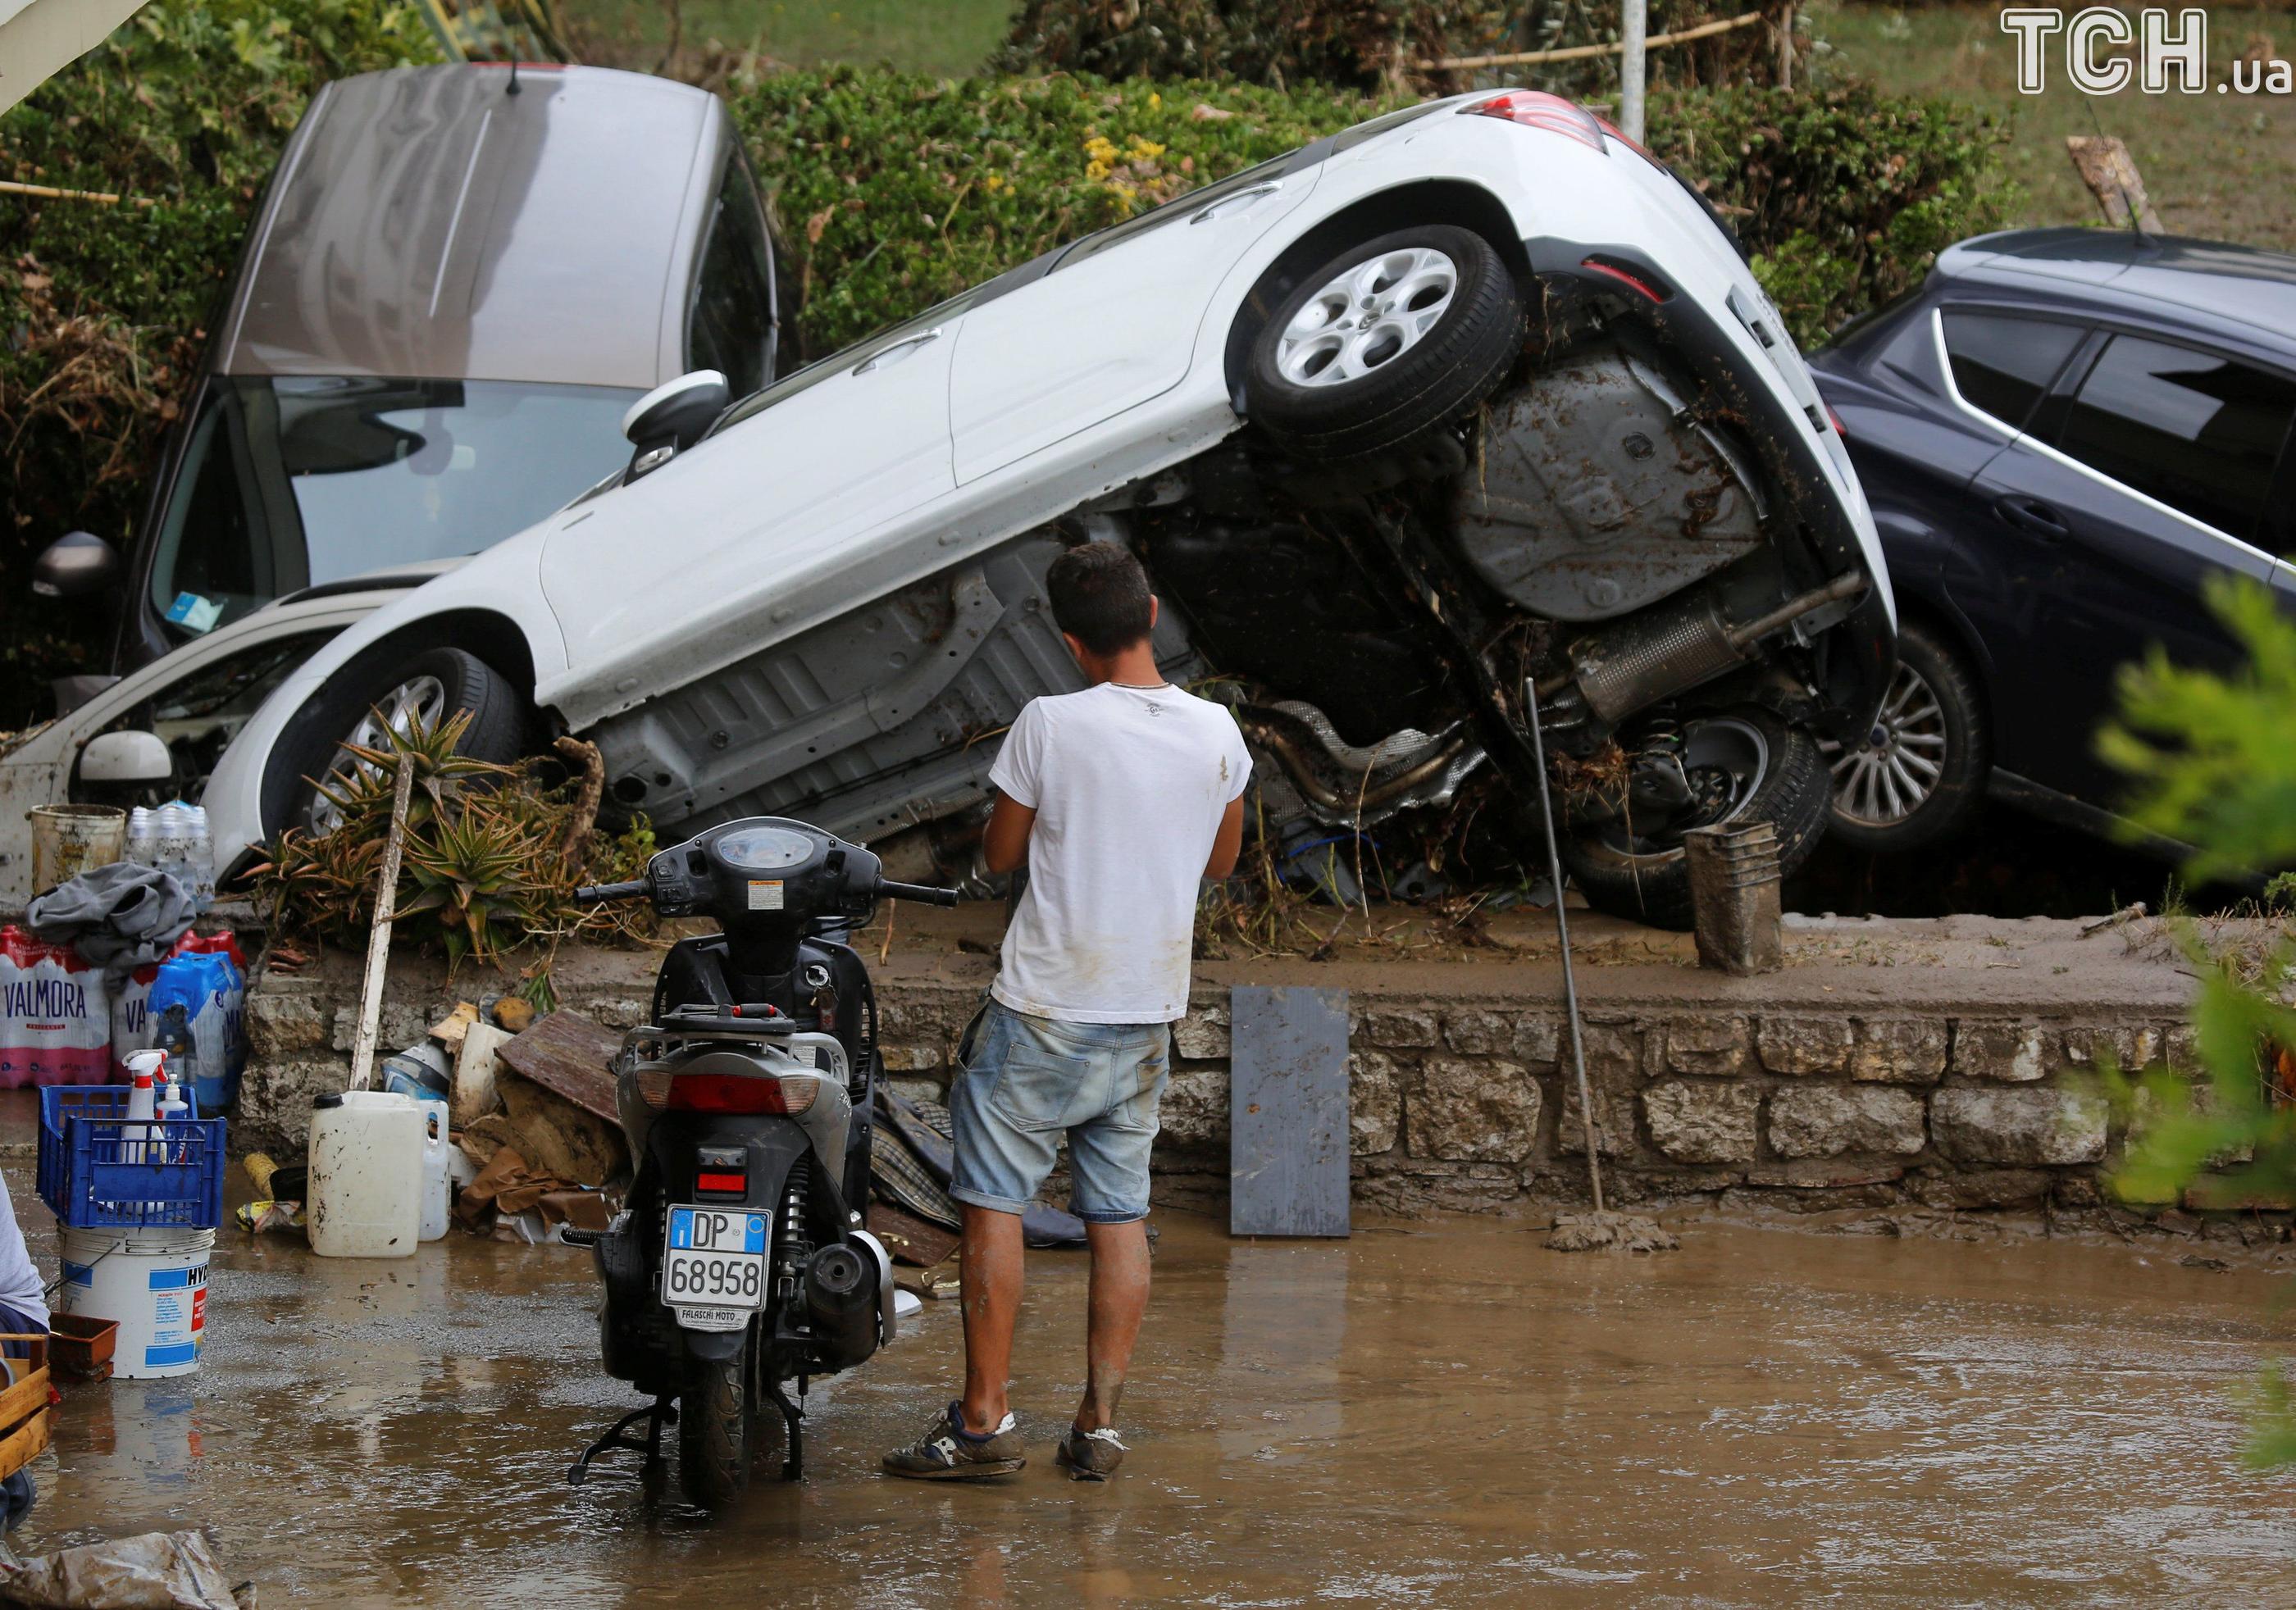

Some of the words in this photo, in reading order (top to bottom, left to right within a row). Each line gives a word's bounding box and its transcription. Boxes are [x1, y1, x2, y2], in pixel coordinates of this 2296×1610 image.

[4, 980, 86, 1018] VALMORA
[693, 1212, 728, 1248] DP
[671, 1258, 759, 1296] 68958
[681, 1309, 713, 1320] FALASCHI
[715, 1312, 736, 1321] MOTO
